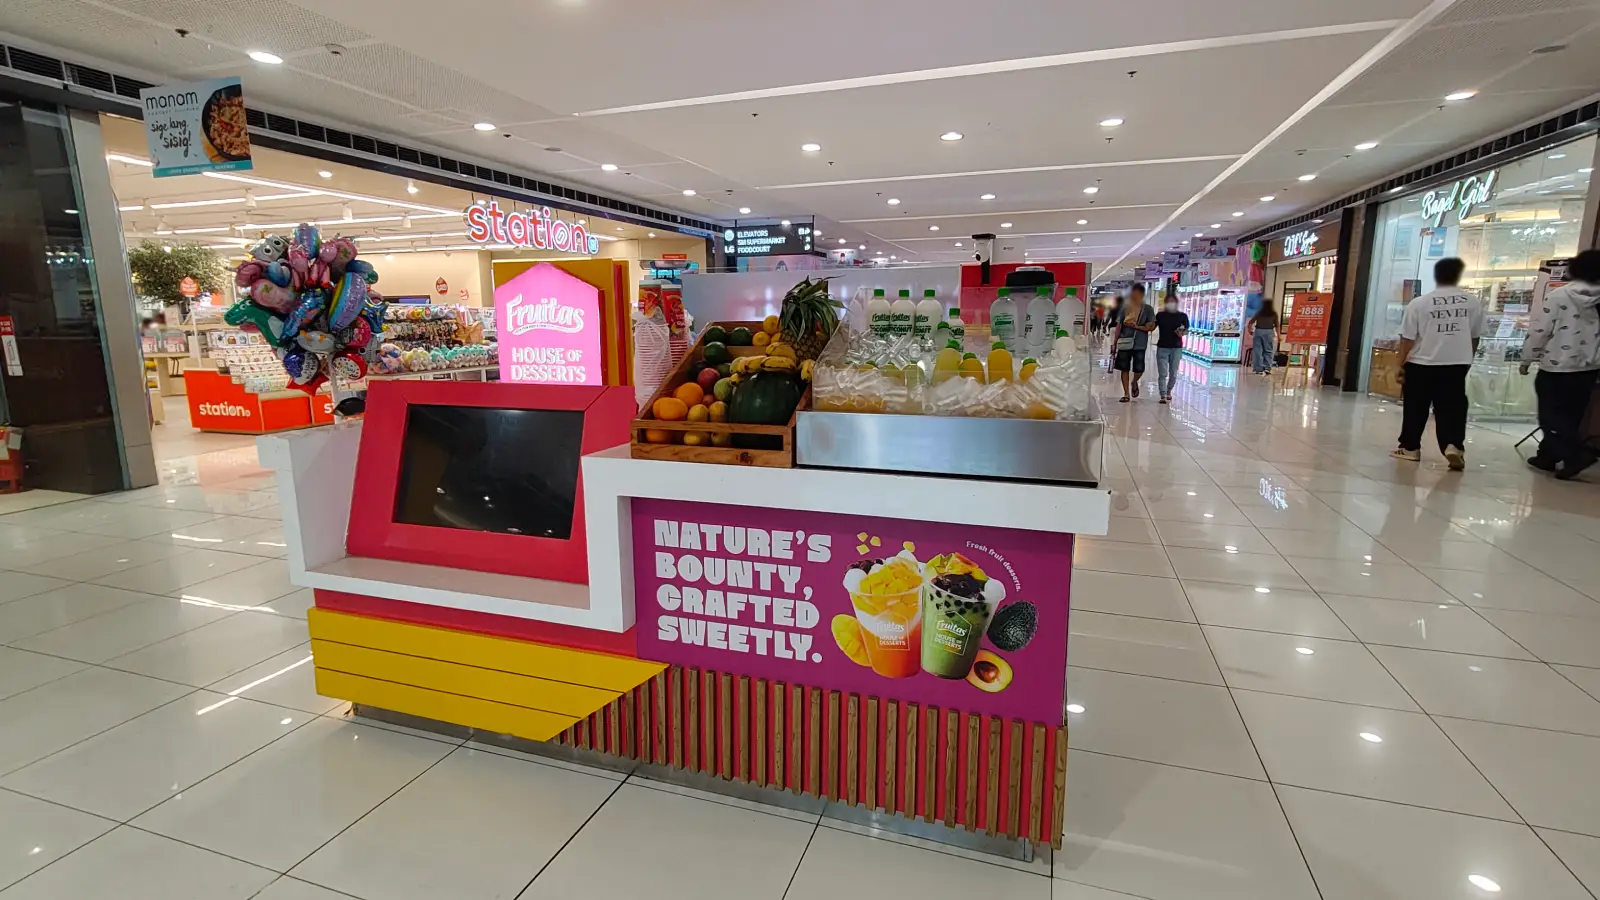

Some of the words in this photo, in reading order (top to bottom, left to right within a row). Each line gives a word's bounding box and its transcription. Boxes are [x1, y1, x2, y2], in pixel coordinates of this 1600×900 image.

[146, 91, 198, 110] manam
[151, 120, 168, 139] sige
[169, 117, 187, 135] lang
[162, 131, 192, 158] sisig!
[1421, 181, 1460, 228] Bagel
[1459, 170, 1495, 220] Girl
[467, 201, 588, 254] station
[737, 230, 768, 238] ELEVATORS
[737, 245, 771, 254] FOODCOURT
[746, 237, 786, 245] SUPERMARKET
[1433, 295, 1467, 305] EYES
[506, 293, 584, 335] Fruitas
[511, 347, 565, 364] HOUSE
[568, 349, 583, 362] OF
[511, 364, 586, 383] DESSERTS
[199, 401, 245, 416] station
[966, 540, 988, 552] Fresh
[988, 548, 1004, 562] fruit
[655, 551, 813, 600] BOUNTY,
[656, 583, 820, 629] CRAFTED
[935, 633, 955, 643] HOUSE
[936, 620, 967, 637] Fruitas
[657, 615, 823, 663] SWEETLY.
[934, 637, 962, 650] DESSERTS
